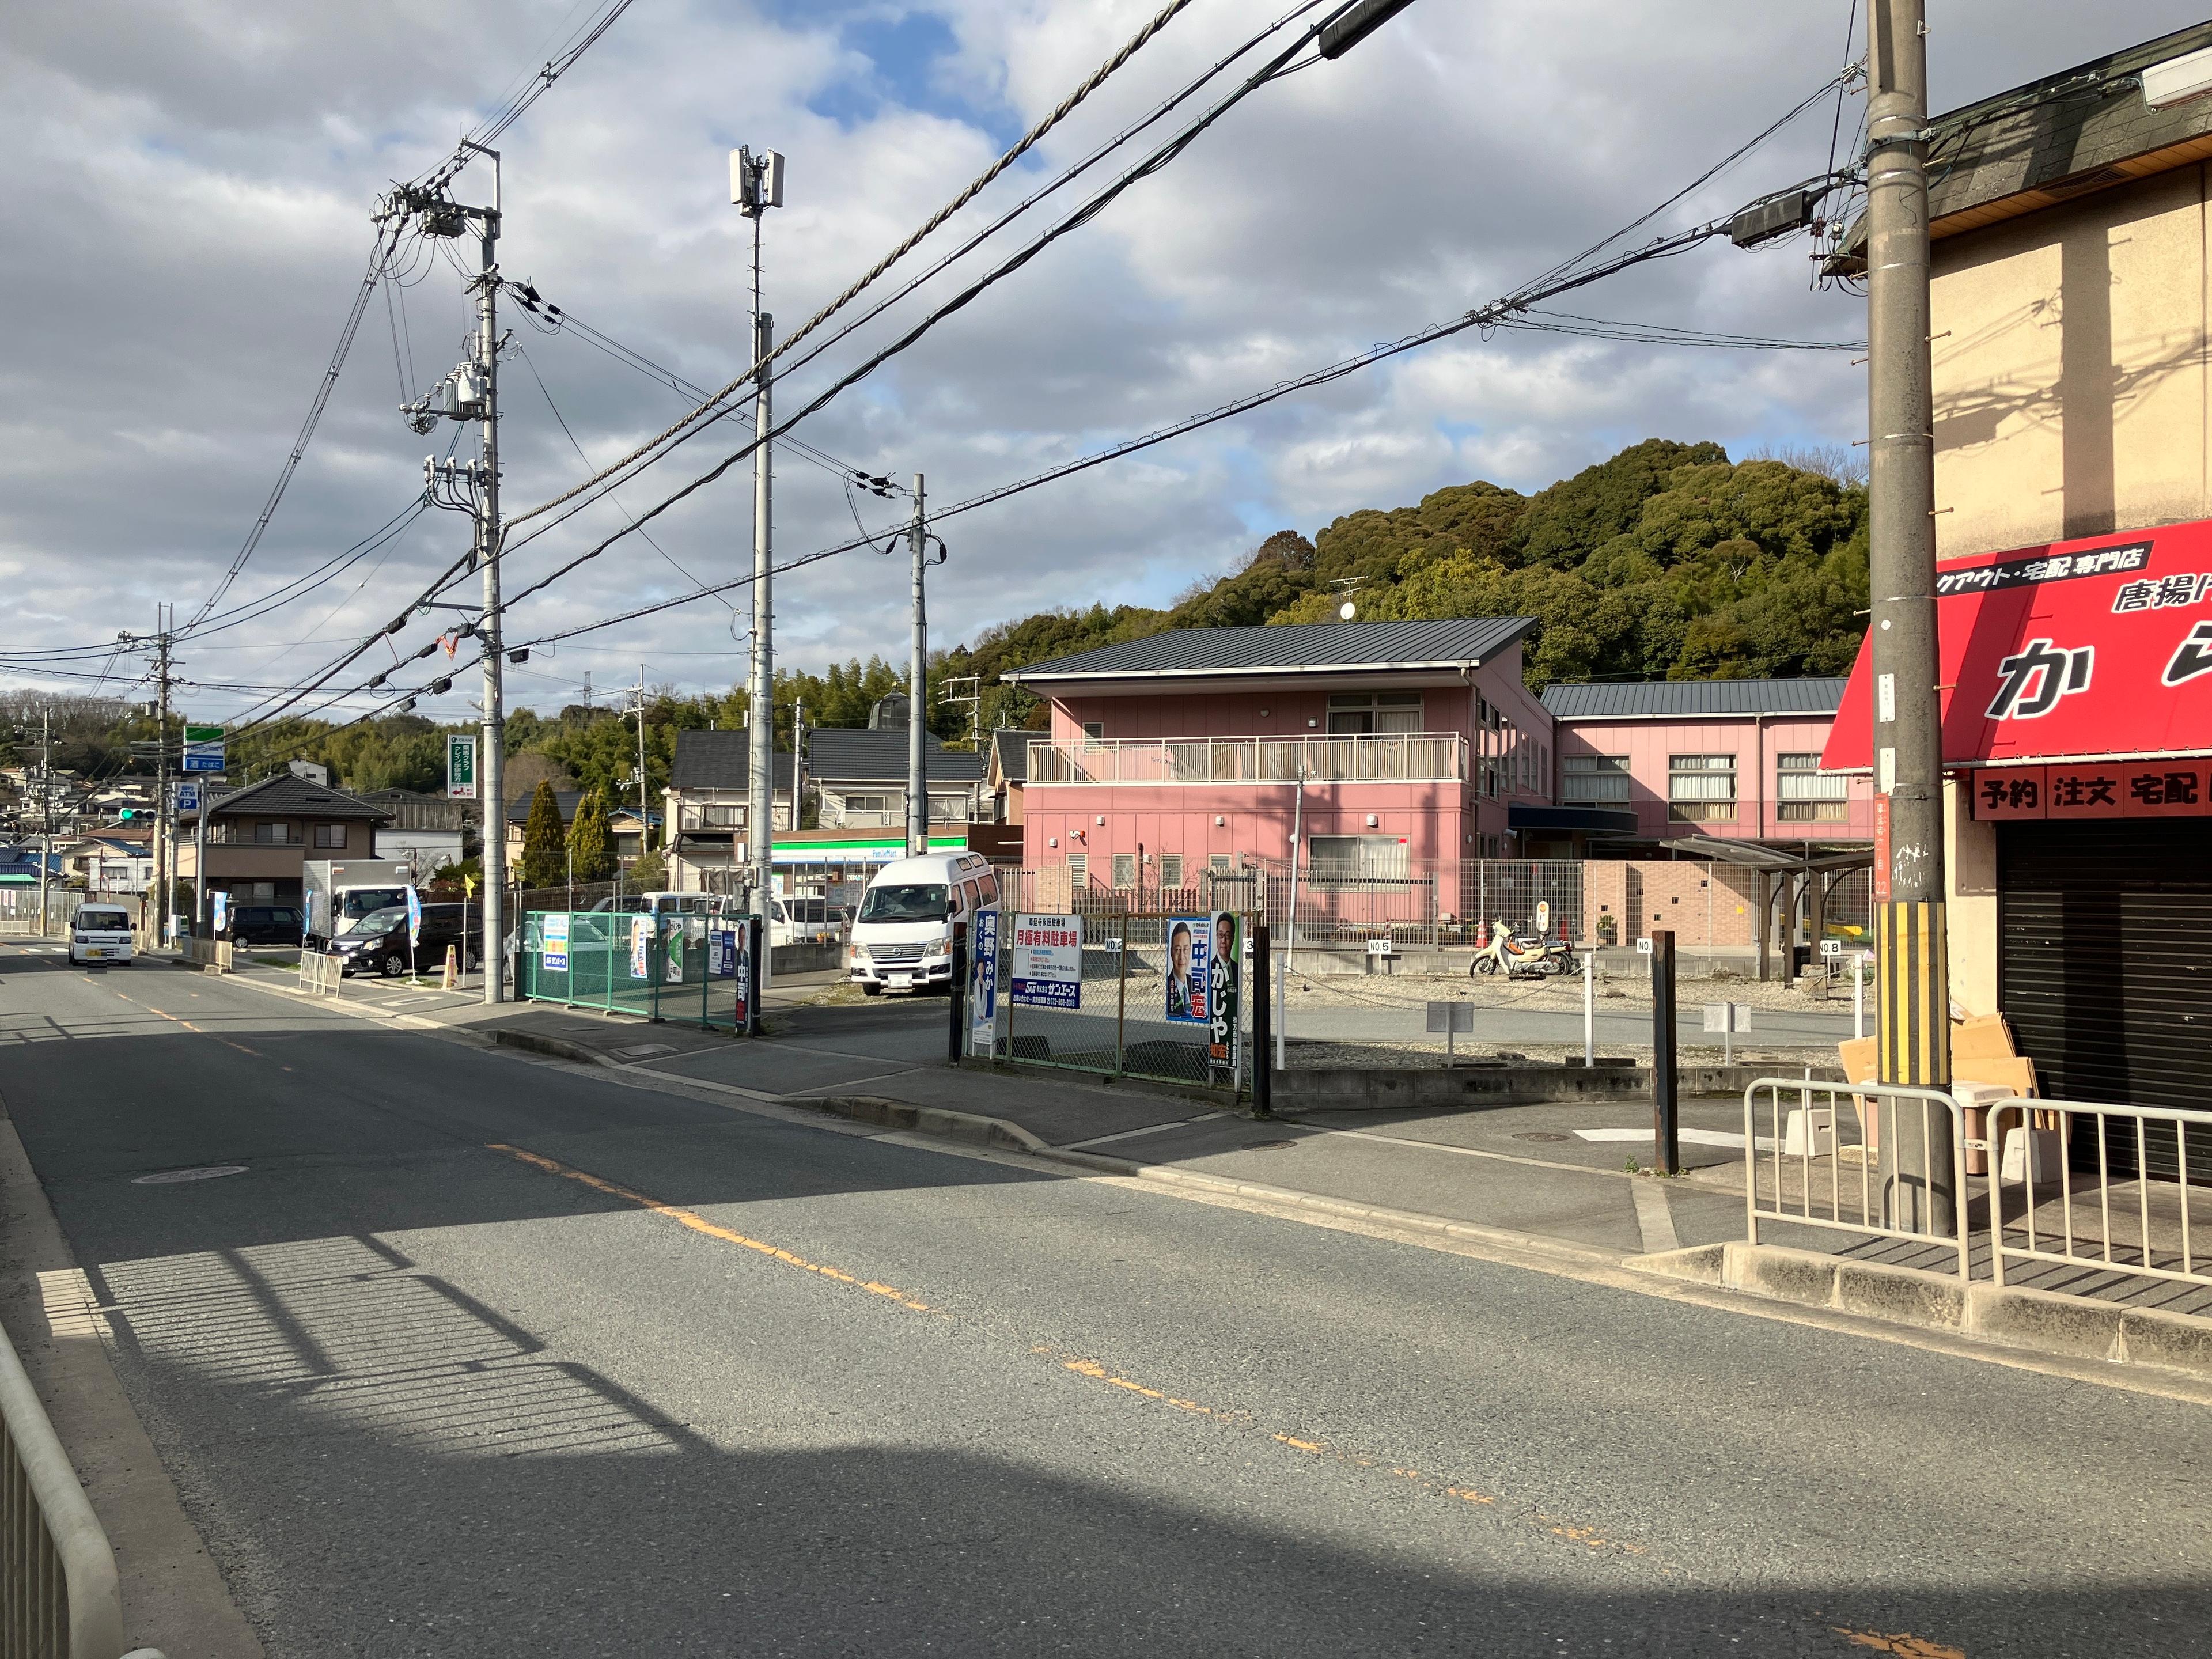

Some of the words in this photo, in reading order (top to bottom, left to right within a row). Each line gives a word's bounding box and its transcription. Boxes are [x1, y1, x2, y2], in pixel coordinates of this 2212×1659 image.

[2074, 548, 2145, 574] 専門店
[1981, 779, 2038, 809] 予約
[2054, 776, 2117, 806] 注文
[2130, 772, 2198, 805] 宅配
[873, 849, 896, 859] FamilyMart
[1876, 881, 1888, 895] 22
[1029, 918, 1066, 927] 尊延寺永田駐車場
[1016, 929, 1077, 948] 月極有料駐車場
[1371, 942, 1389, 951] NO.5
[983, 914, 995, 991] 奥野みか
[1048, 983, 1076, 997] サンエース
[1191, 939, 1207, 1019] 中司宏
[1210, 963, 1230, 1043] かじや
